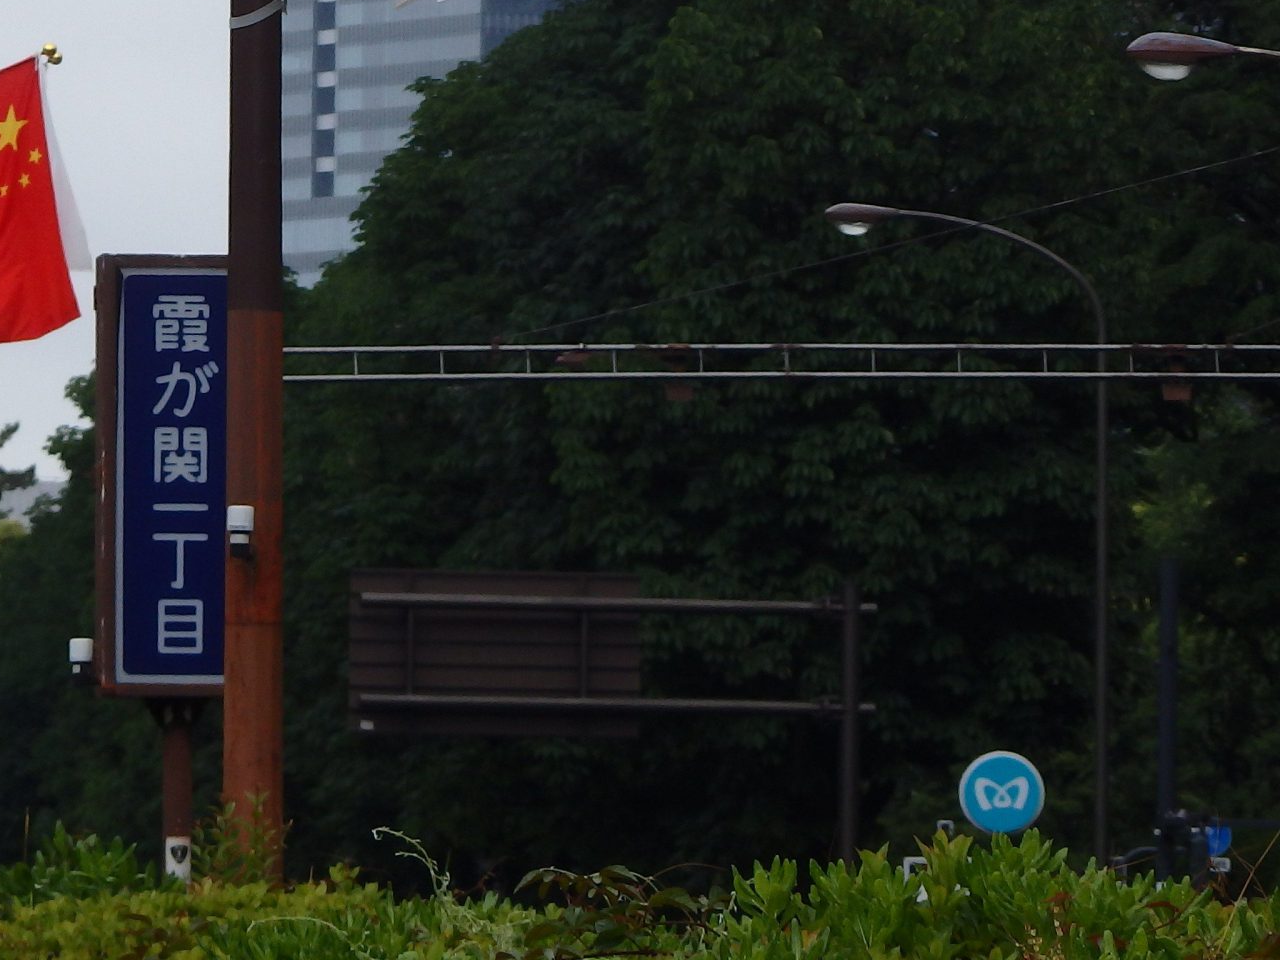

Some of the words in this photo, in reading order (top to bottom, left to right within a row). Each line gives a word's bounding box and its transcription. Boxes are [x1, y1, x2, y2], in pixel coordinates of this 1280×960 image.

[152, 295, 219, 654] 霞が関一丁目
